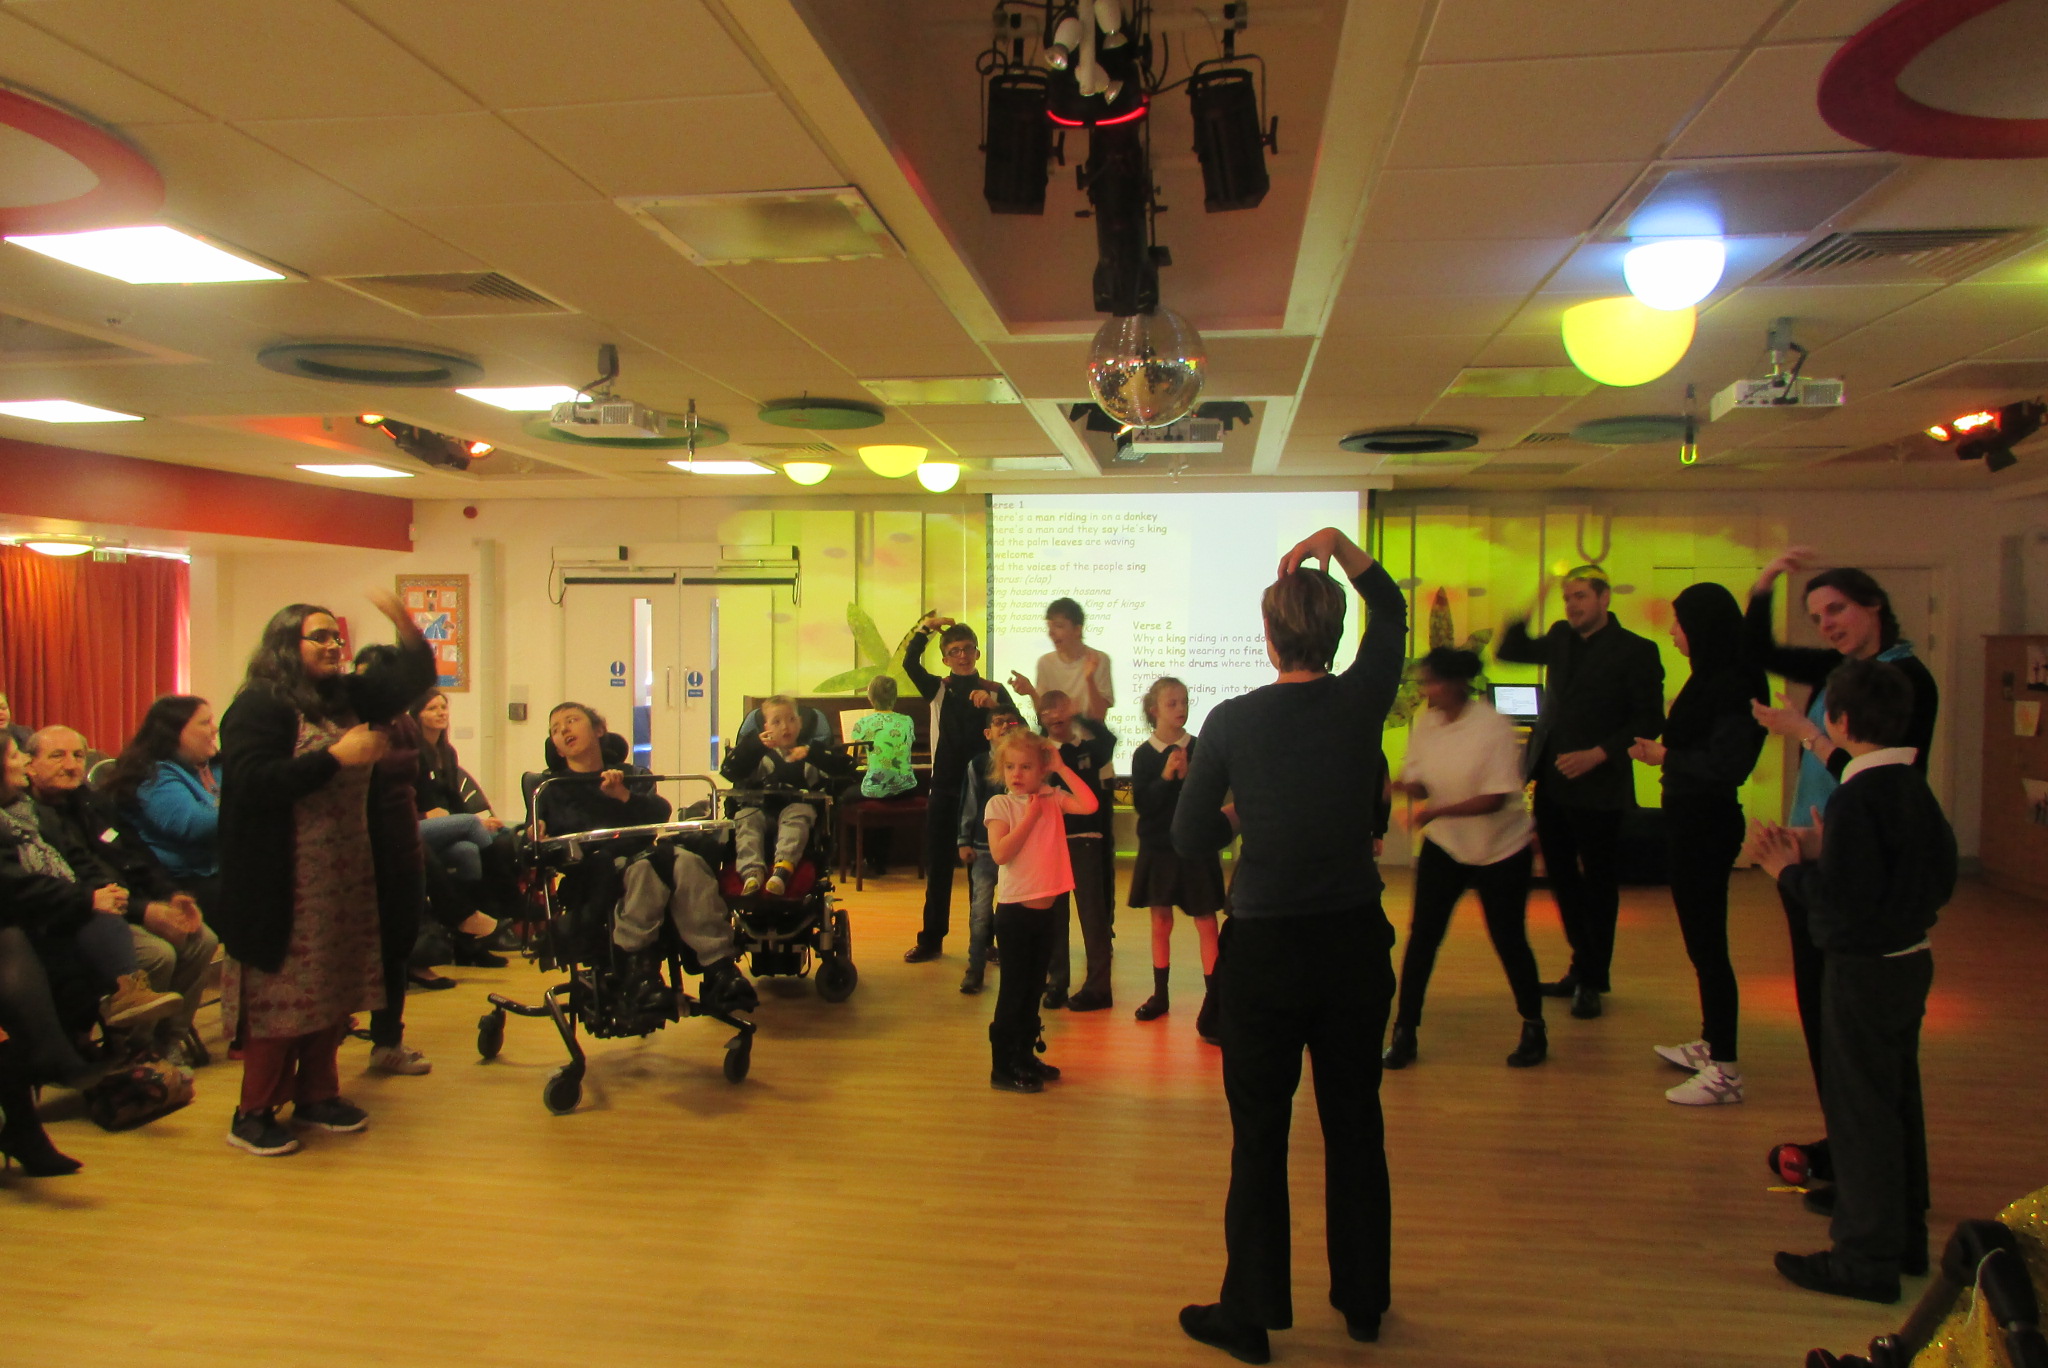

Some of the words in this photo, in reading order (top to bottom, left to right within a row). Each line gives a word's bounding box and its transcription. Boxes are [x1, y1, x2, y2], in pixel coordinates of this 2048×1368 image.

[1019, 501, 1024, 509] 1
[1059, 513, 1087, 523] riding
[1124, 512, 1158, 523] donkey
[1057, 525, 1074, 533] and
[1077, 525, 1099, 535] they
[1102, 527, 1119, 535] say
[1121, 524, 1144, 533] He's
[1147, 525, 1167, 535] king
[1008, 537, 1024, 546] the
[1027, 537, 1049, 548] palm
[1052, 537, 1083, 546] leaves
[1104, 537, 1135, 548] waving
[995, 550, 1034, 559] welcome
[1008, 562, 1024, 571] the
[1027, 562, 1057, 571] voices
[1060, 562, 1070, 571] of
[1073, 562, 1089, 571] the
[1093, 562, 1123, 573] people
[1127, 563, 1146, 573] sing
[1025, 574, 1052, 586] (clap)
[1010, 587, 1048, 596] hosanna
[1051, 587, 1070, 598] sing
[1073, 587, 1111, 596] hosanna
[1084, 600, 1104, 610] King
[1107, 599, 1119, 608] of
[1121, 600, 1146, 610] kings
[1010, 612, 1044, 621] hosann
[1132, 621, 1161, 630] Verse
[1166, 621, 1172, 630] 2
[1132, 633, 1155, 645] Why
[1166, 633, 1186, 645] king
[1189, 633, 1217, 645] riding
[1220, 633, 1228, 642] in
[1132, 646, 1155, 657] Why
[1166, 646, 1186, 657] king
[1189, 646, 1226, 658] wearing
[1243, 646, 1264, 655] fine
[1133, 658, 1165, 668] Where
[1169, 659, 1185, 667] the
[1189, 658, 1218, 667] drums
[1221, 659, 1251, 668] where
[1255, 659, 1271, 667] the
[1133, 684, 1143, 692] If
[1188, 684, 1217, 695] riding
[1221, 684, 1240, 692] into
[1105, 714, 1123, 724] ing
